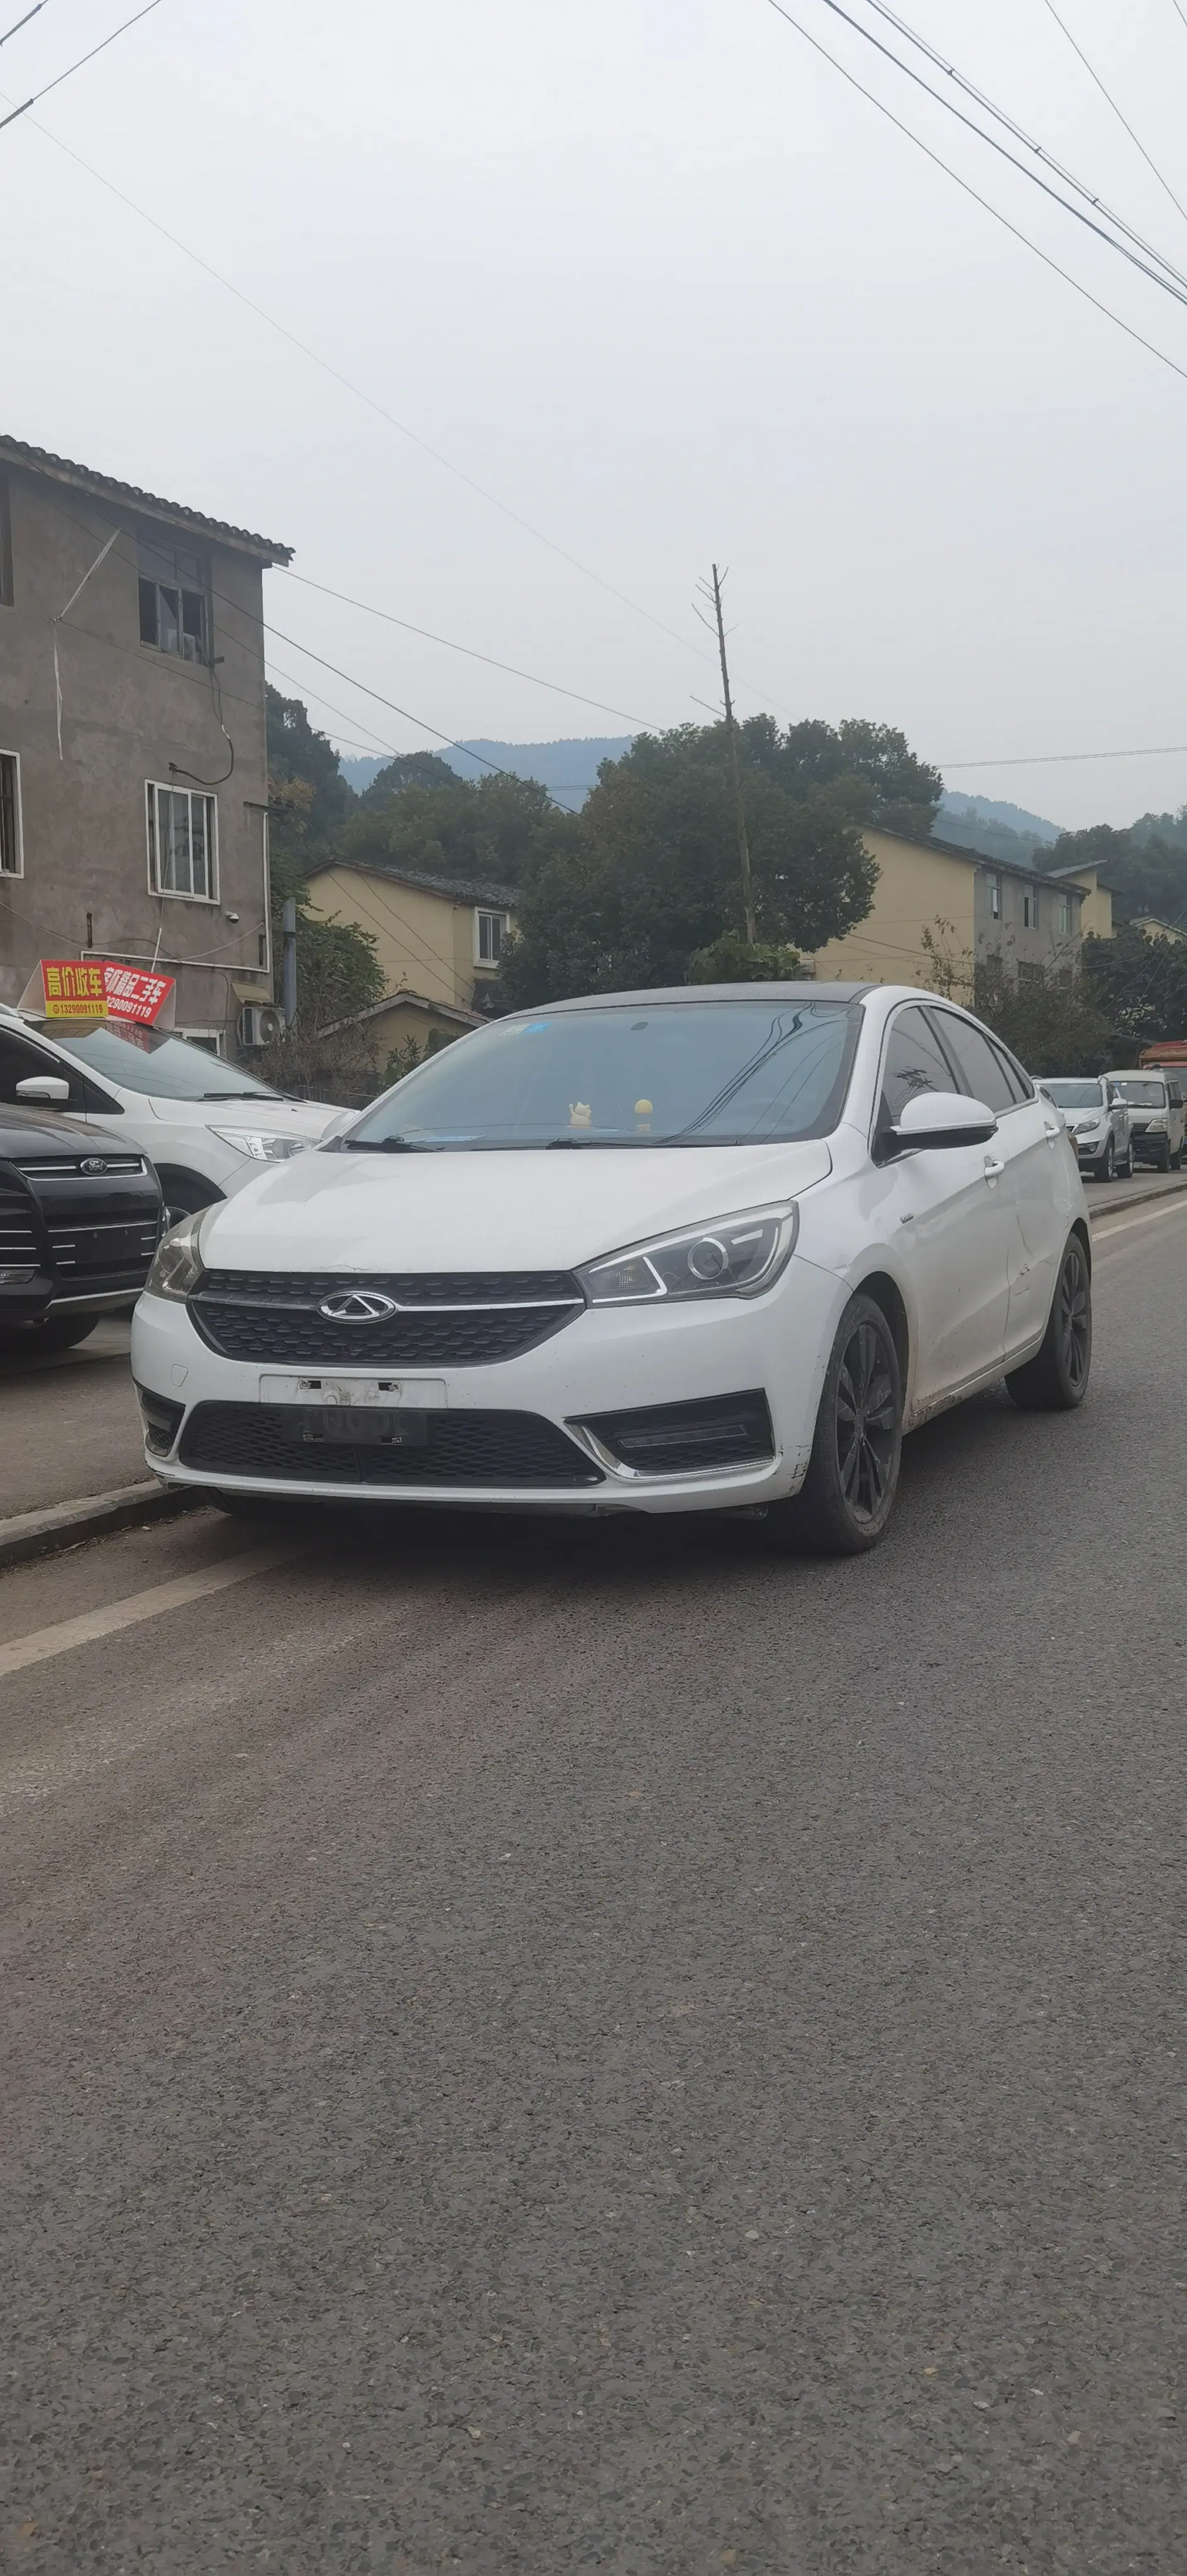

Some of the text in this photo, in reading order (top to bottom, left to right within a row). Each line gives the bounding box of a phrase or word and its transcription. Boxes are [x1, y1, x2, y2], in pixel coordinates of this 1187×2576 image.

[47, 967, 102, 996] 高价收车
[60, 1004, 102, 1014] 13290091119
